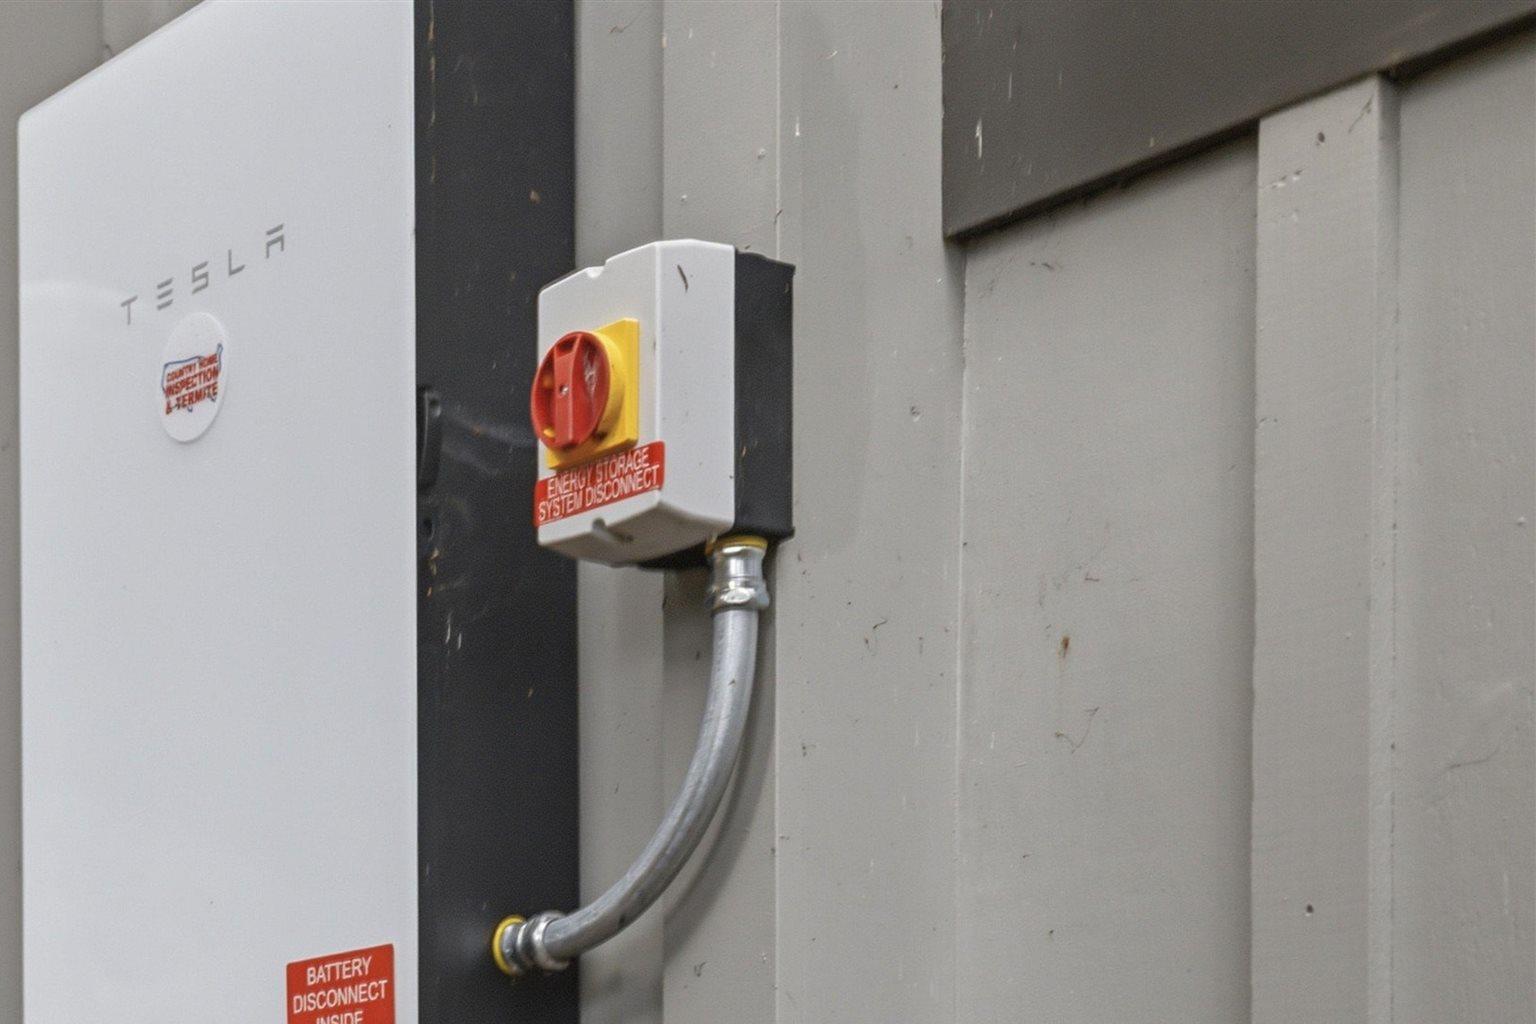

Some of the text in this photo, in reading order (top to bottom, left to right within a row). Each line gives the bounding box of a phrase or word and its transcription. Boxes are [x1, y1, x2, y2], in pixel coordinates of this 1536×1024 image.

[120, 223, 285, 325] TESLA
[166, 366, 219, 396] INSPECTION
[176, 382, 218, 409] TERMITE
[547, 447, 650, 498] ENERGY STORAGE
[538, 464, 660, 521] SYSTEM DISCONNECT
[306, 956, 372, 986] BATTERY
[293, 980, 388, 1014] DISCONNECT
